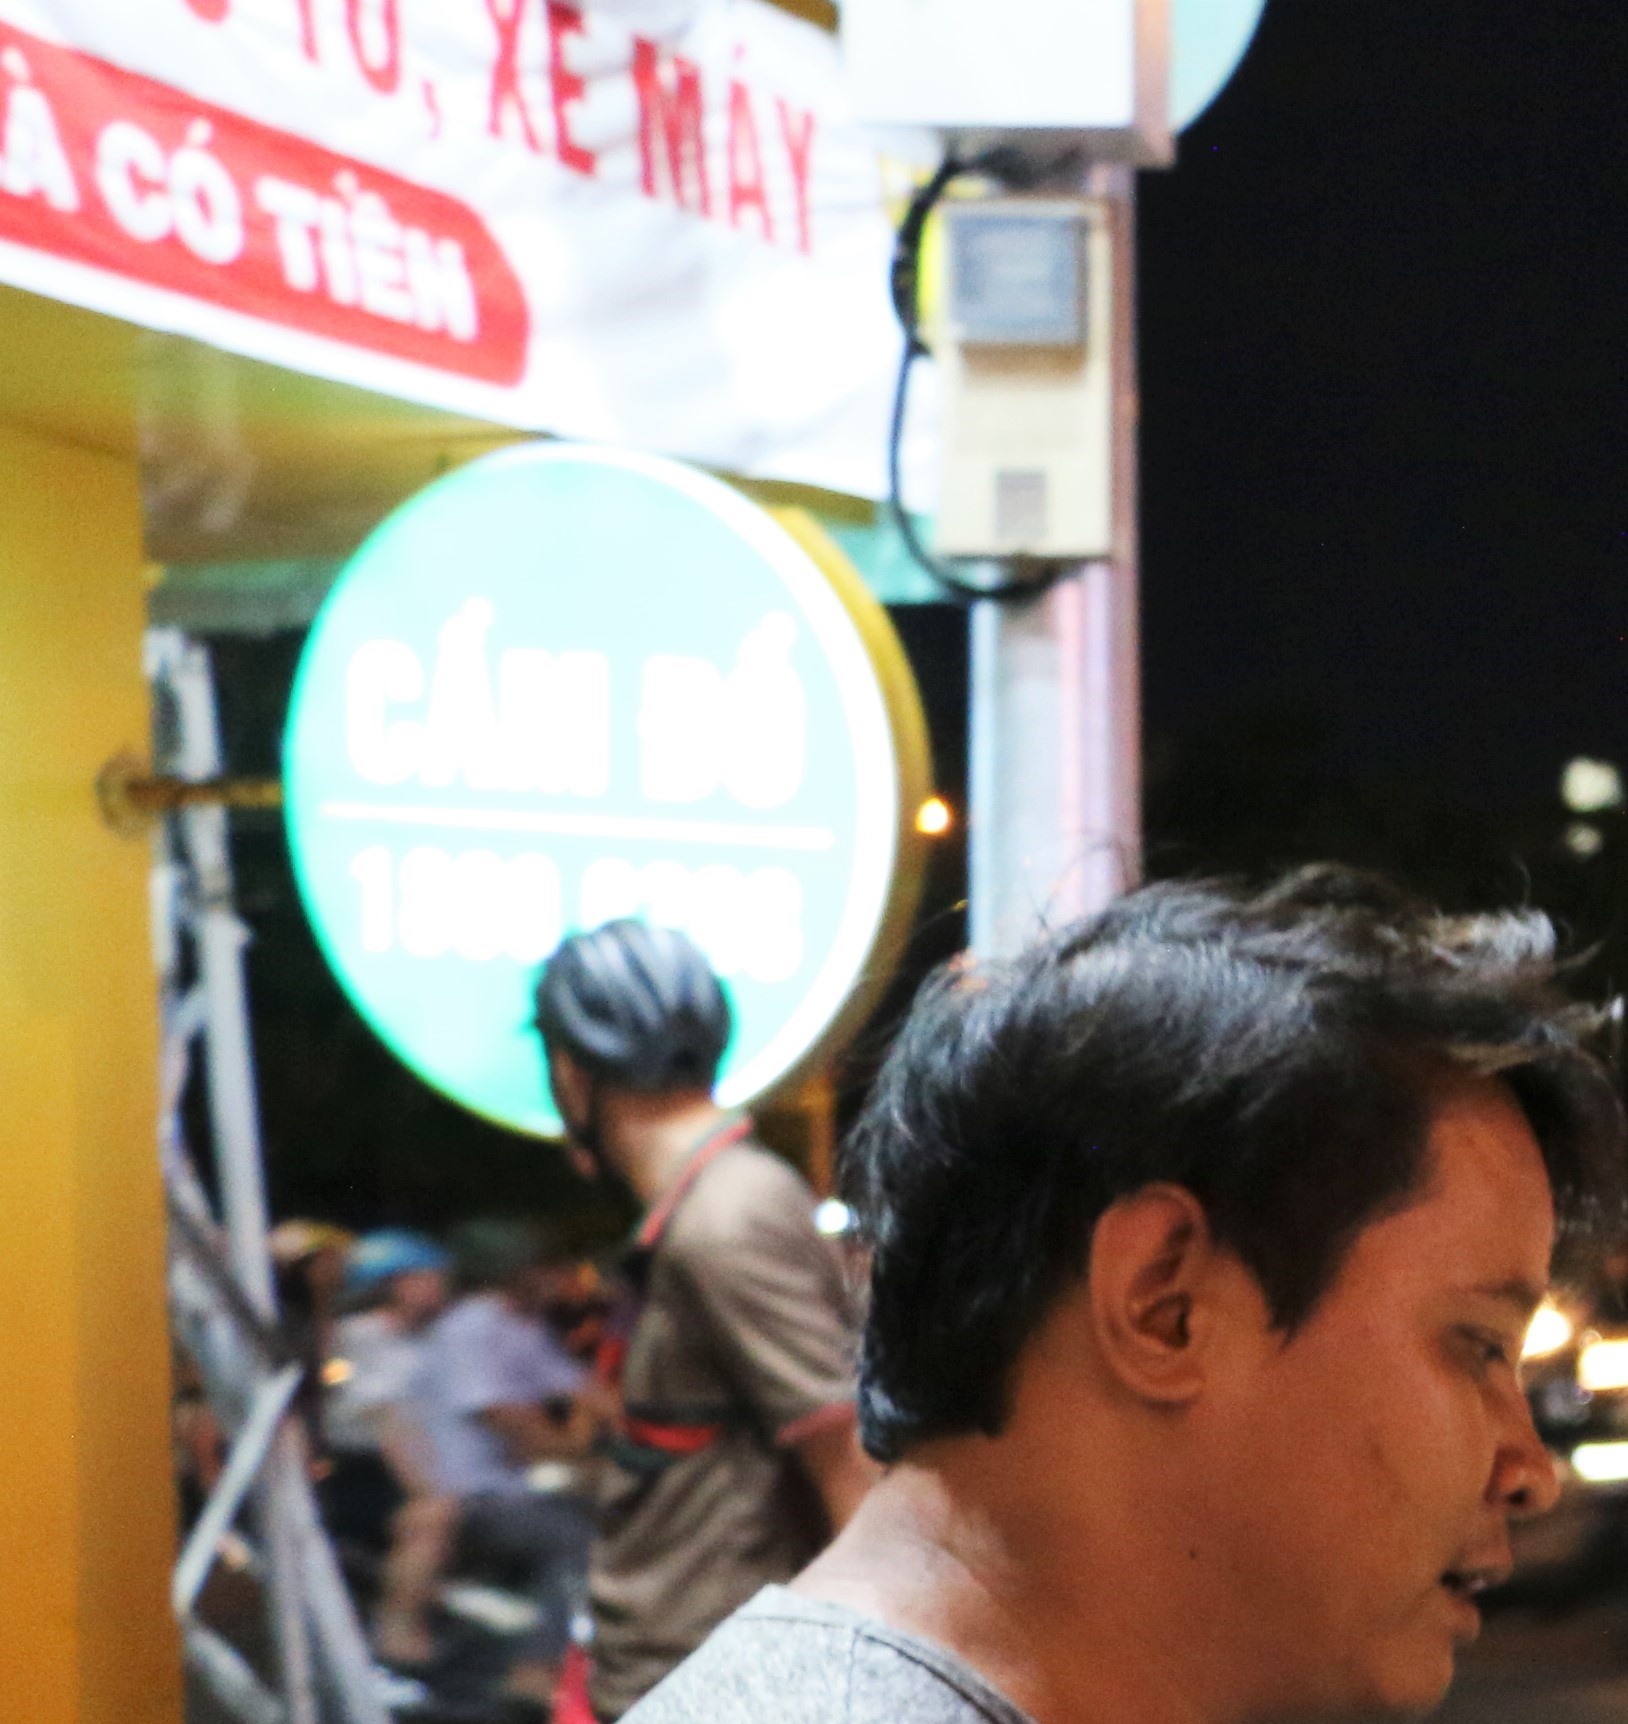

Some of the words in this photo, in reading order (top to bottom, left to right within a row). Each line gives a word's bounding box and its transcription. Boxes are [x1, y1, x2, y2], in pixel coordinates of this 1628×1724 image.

[95, 114, 246, 264] CÓ
[253, 167, 480, 343] TIỀN
[630, 32, 818, 258] MÁY
